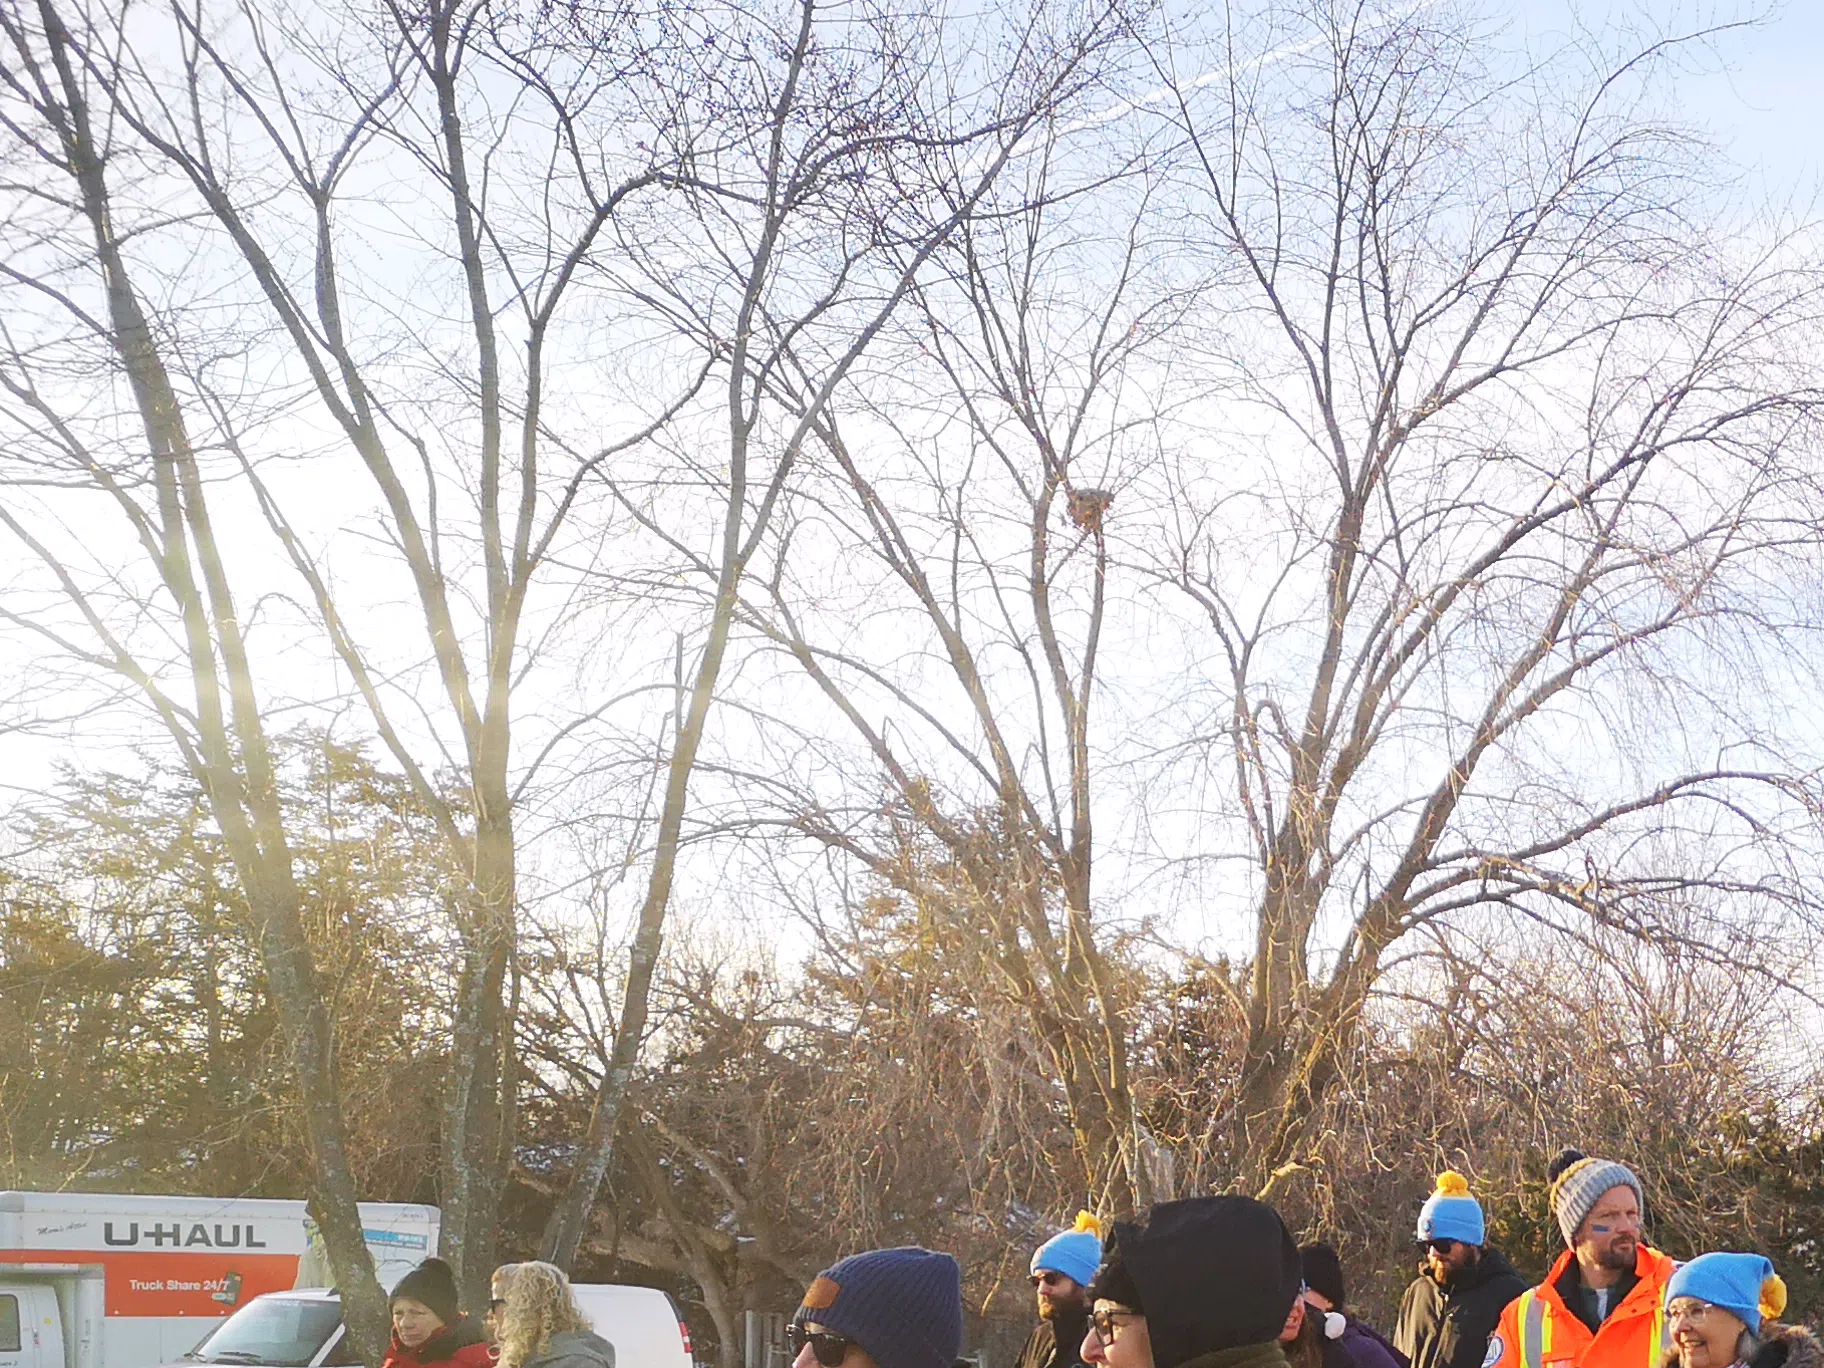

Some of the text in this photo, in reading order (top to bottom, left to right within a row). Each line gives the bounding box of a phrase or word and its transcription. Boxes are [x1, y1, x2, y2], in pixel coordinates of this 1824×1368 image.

[104, 1222, 266, 1248] U-HAUL
[129, 1279, 230, 1291] Truck Share 24/7
